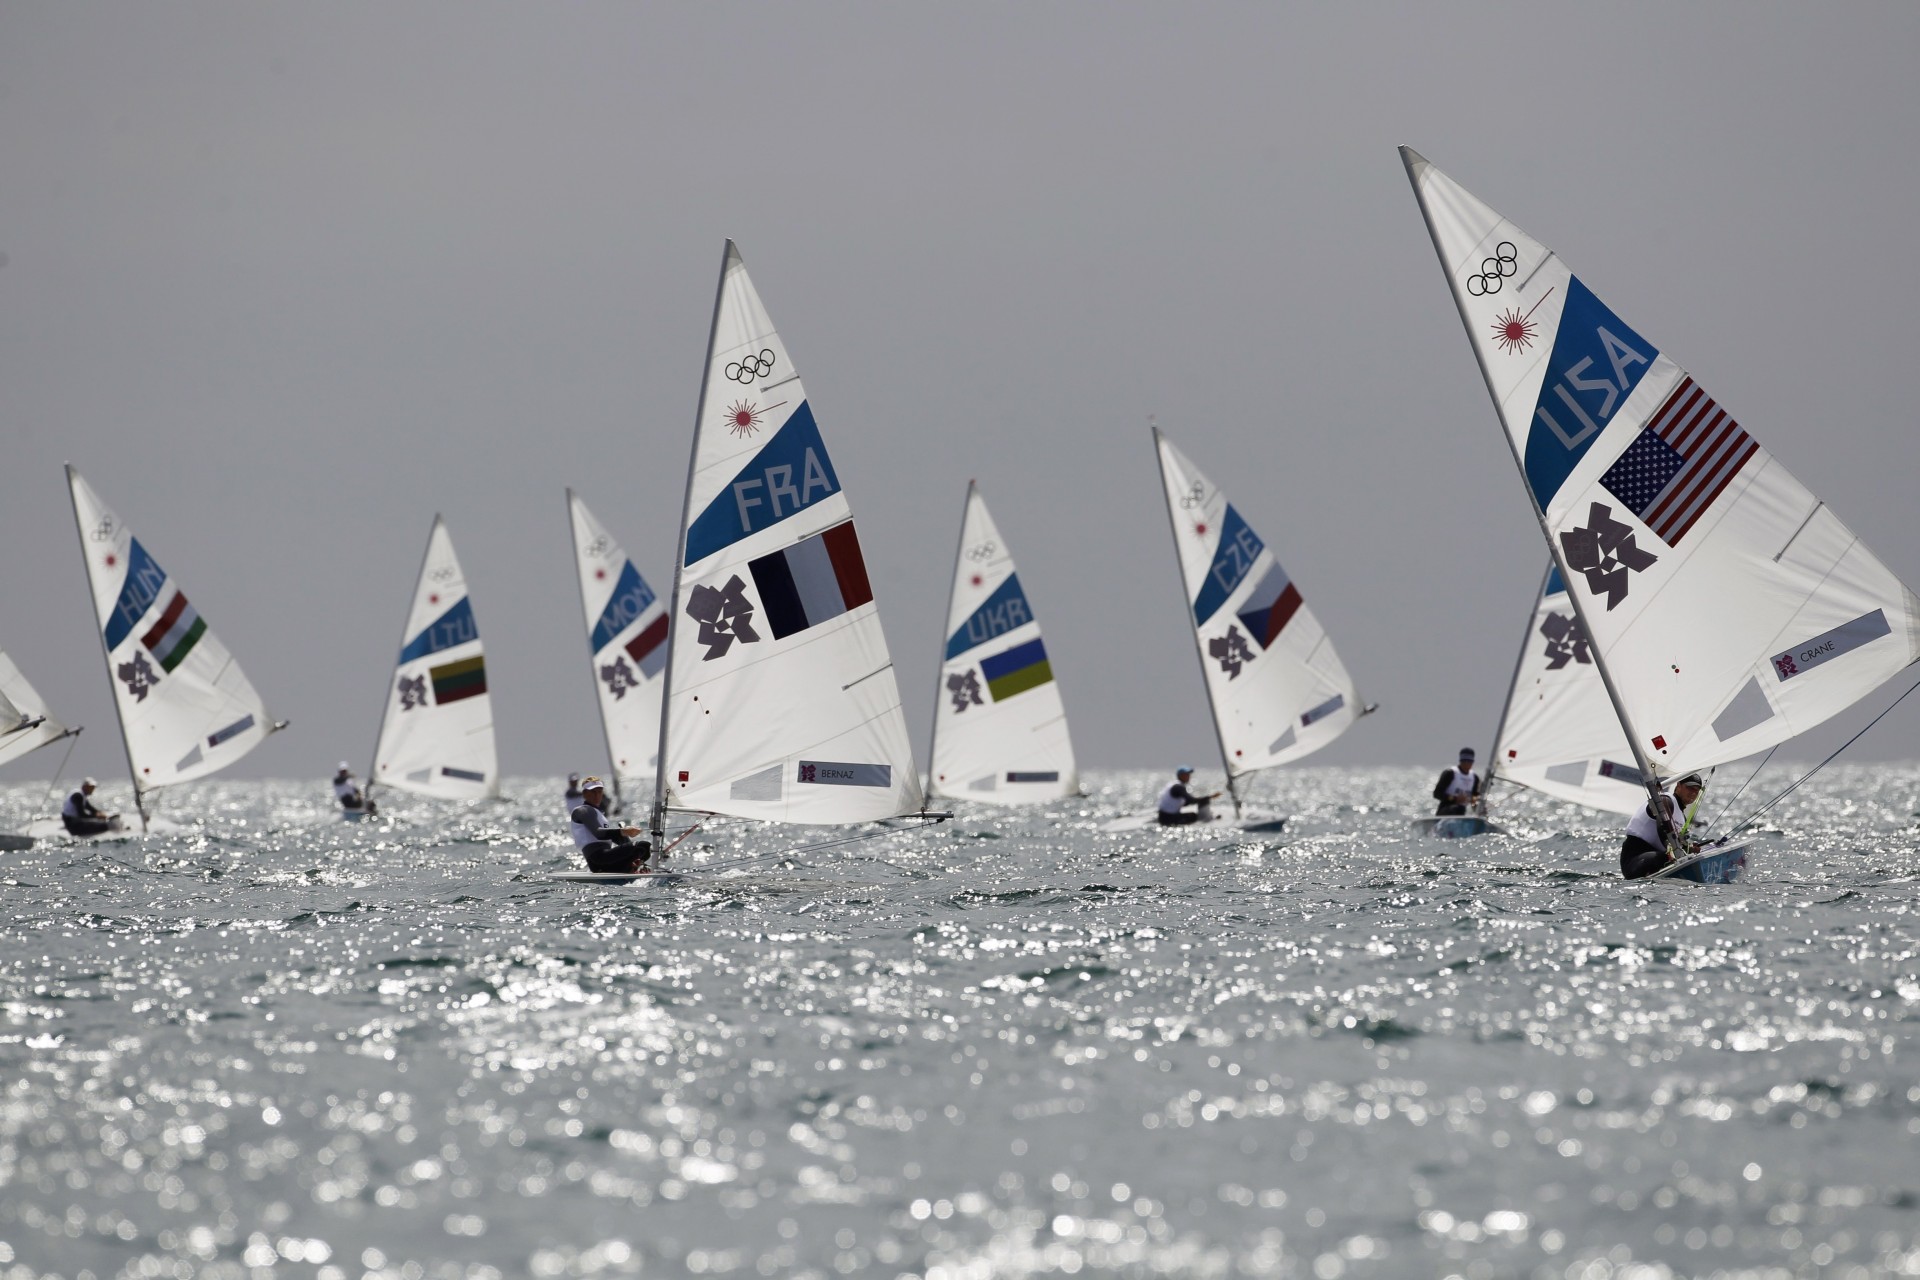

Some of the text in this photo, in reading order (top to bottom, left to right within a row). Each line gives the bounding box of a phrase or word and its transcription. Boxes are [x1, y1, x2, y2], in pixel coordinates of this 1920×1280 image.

[1536, 326, 1649, 451] USA
[733, 446, 832, 532] FRA
[1212, 527, 1259, 593] CZE
[118, 555, 164, 625] HUN
[602, 580, 653, 638] MON
[430, 615, 476, 651] LTU
[967, 598, 1027, 642] UKR
[1800, 640, 1836, 663] CRANE
[820, 769, 854, 779] BERNAZ
